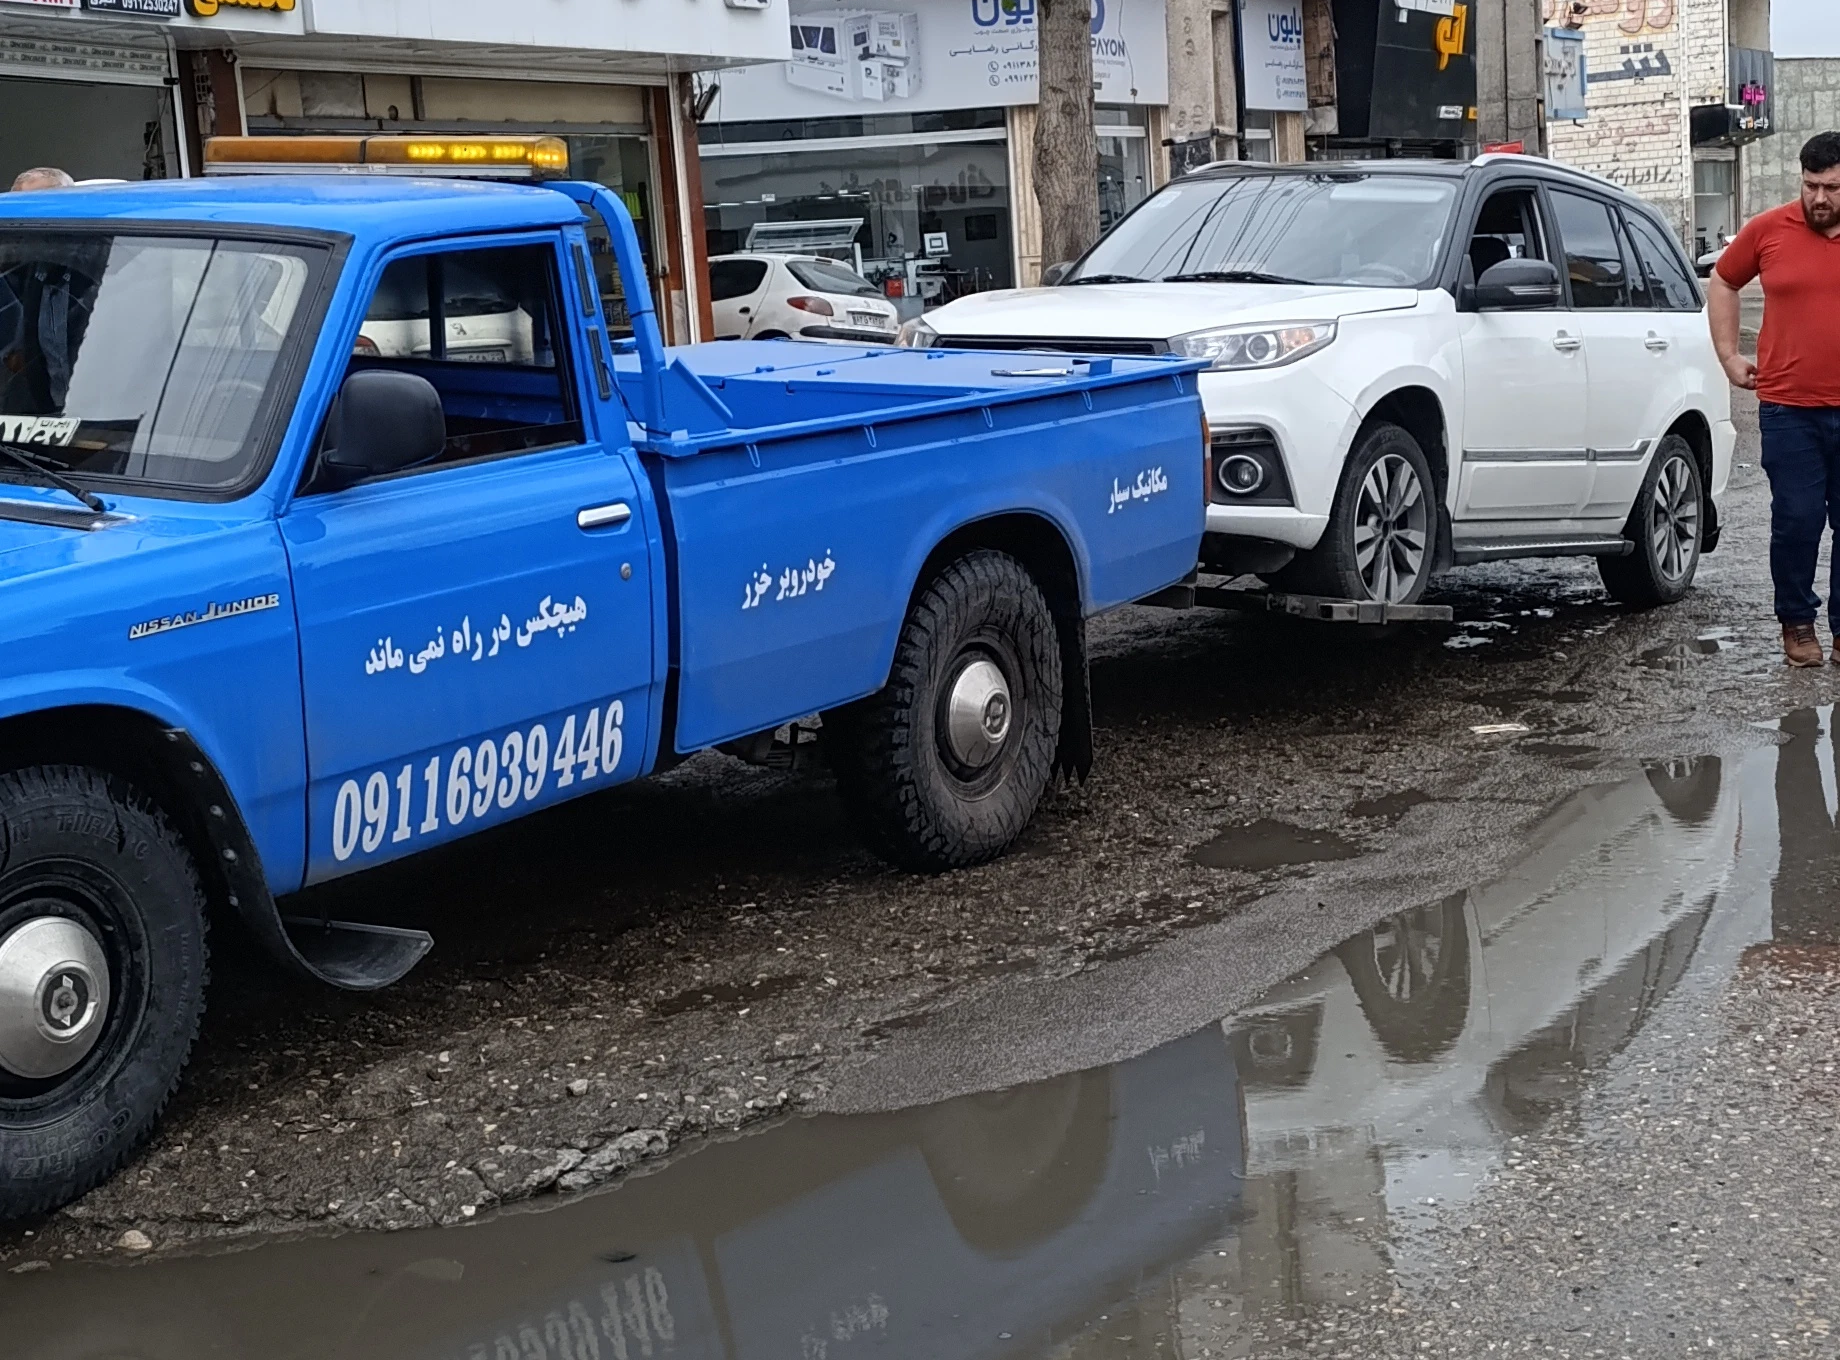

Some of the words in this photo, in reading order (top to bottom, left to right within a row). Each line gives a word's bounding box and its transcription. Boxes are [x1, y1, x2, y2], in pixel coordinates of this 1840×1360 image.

[949, 43, 999, 58] رضایی
[1090, 37, 1126, 58] PAYON
[1107, 476, 1130, 514] سیار
[1131, 466, 1168, 502] مکانیک
[741, 562, 772, 610] خزر
[776, 548, 836, 601] خودروبر
[129, 611, 198, 639] NISSAN
[200, 593, 280, 621] JUNIOR
[452, 615, 483, 661] راه
[488, 613, 511, 658] در
[516, 595, 587, 647] هیچکس
[365, 637, 403, 675] ماند
[409, 626, 445, 674] نمی
[332, 699, 625, 861] 09116939446
